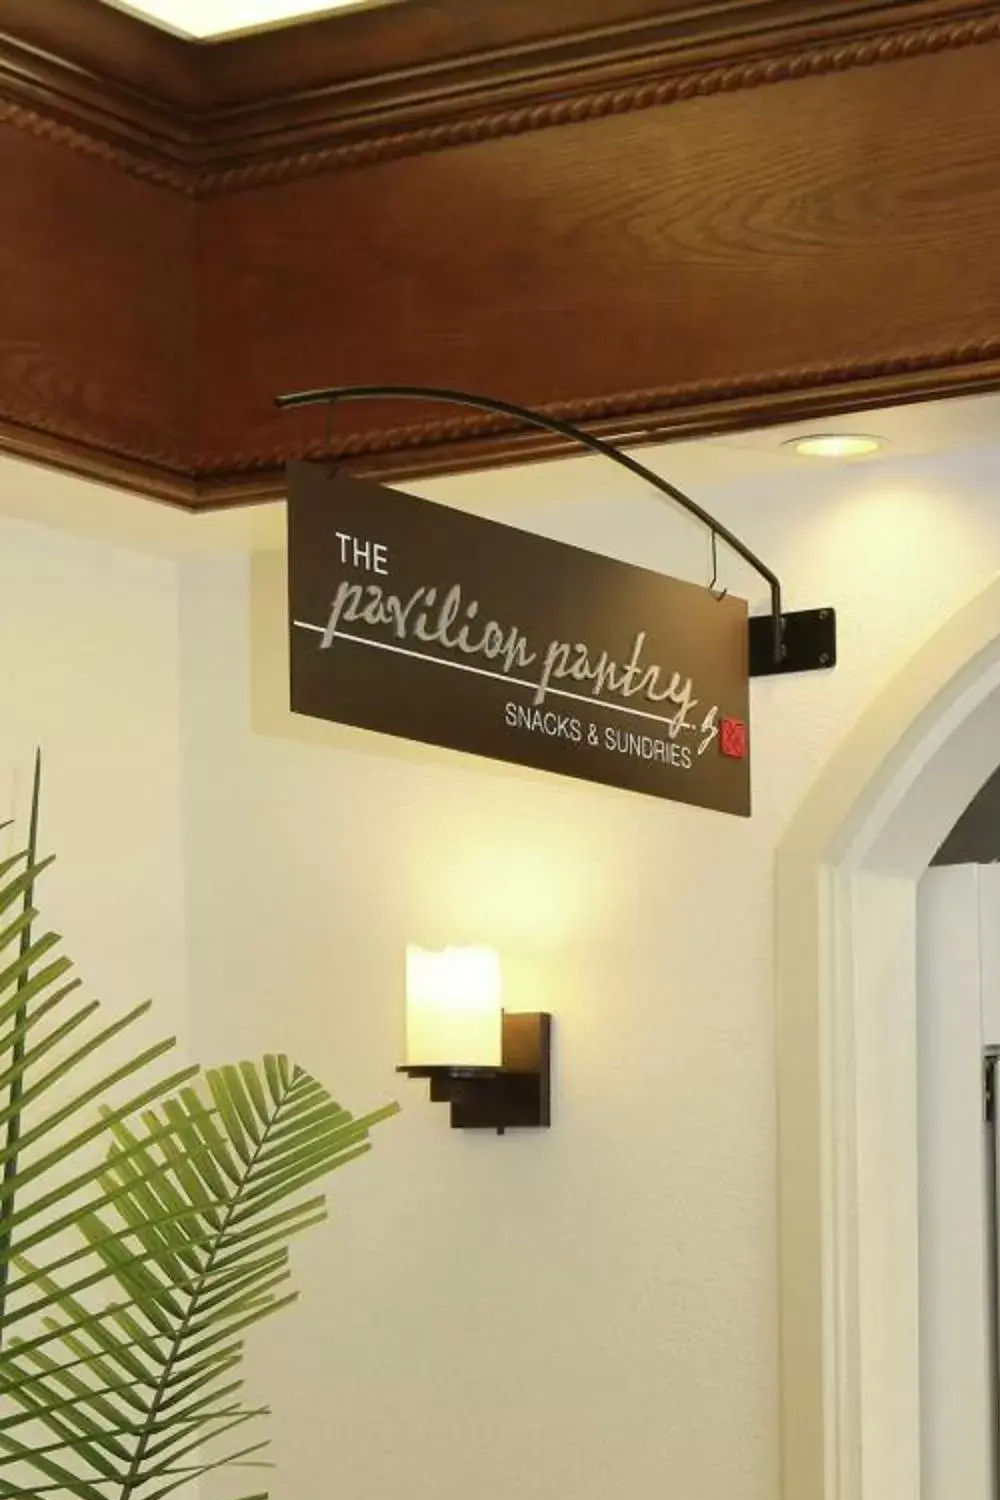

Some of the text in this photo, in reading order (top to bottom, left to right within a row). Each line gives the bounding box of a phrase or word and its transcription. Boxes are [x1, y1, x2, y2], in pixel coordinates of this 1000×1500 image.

[335, 532, 389, 575] THE
[320, 580, 698, 737] pavilion pantry
[505, 702, 693, 769] SNACKS & SUNDRIES
